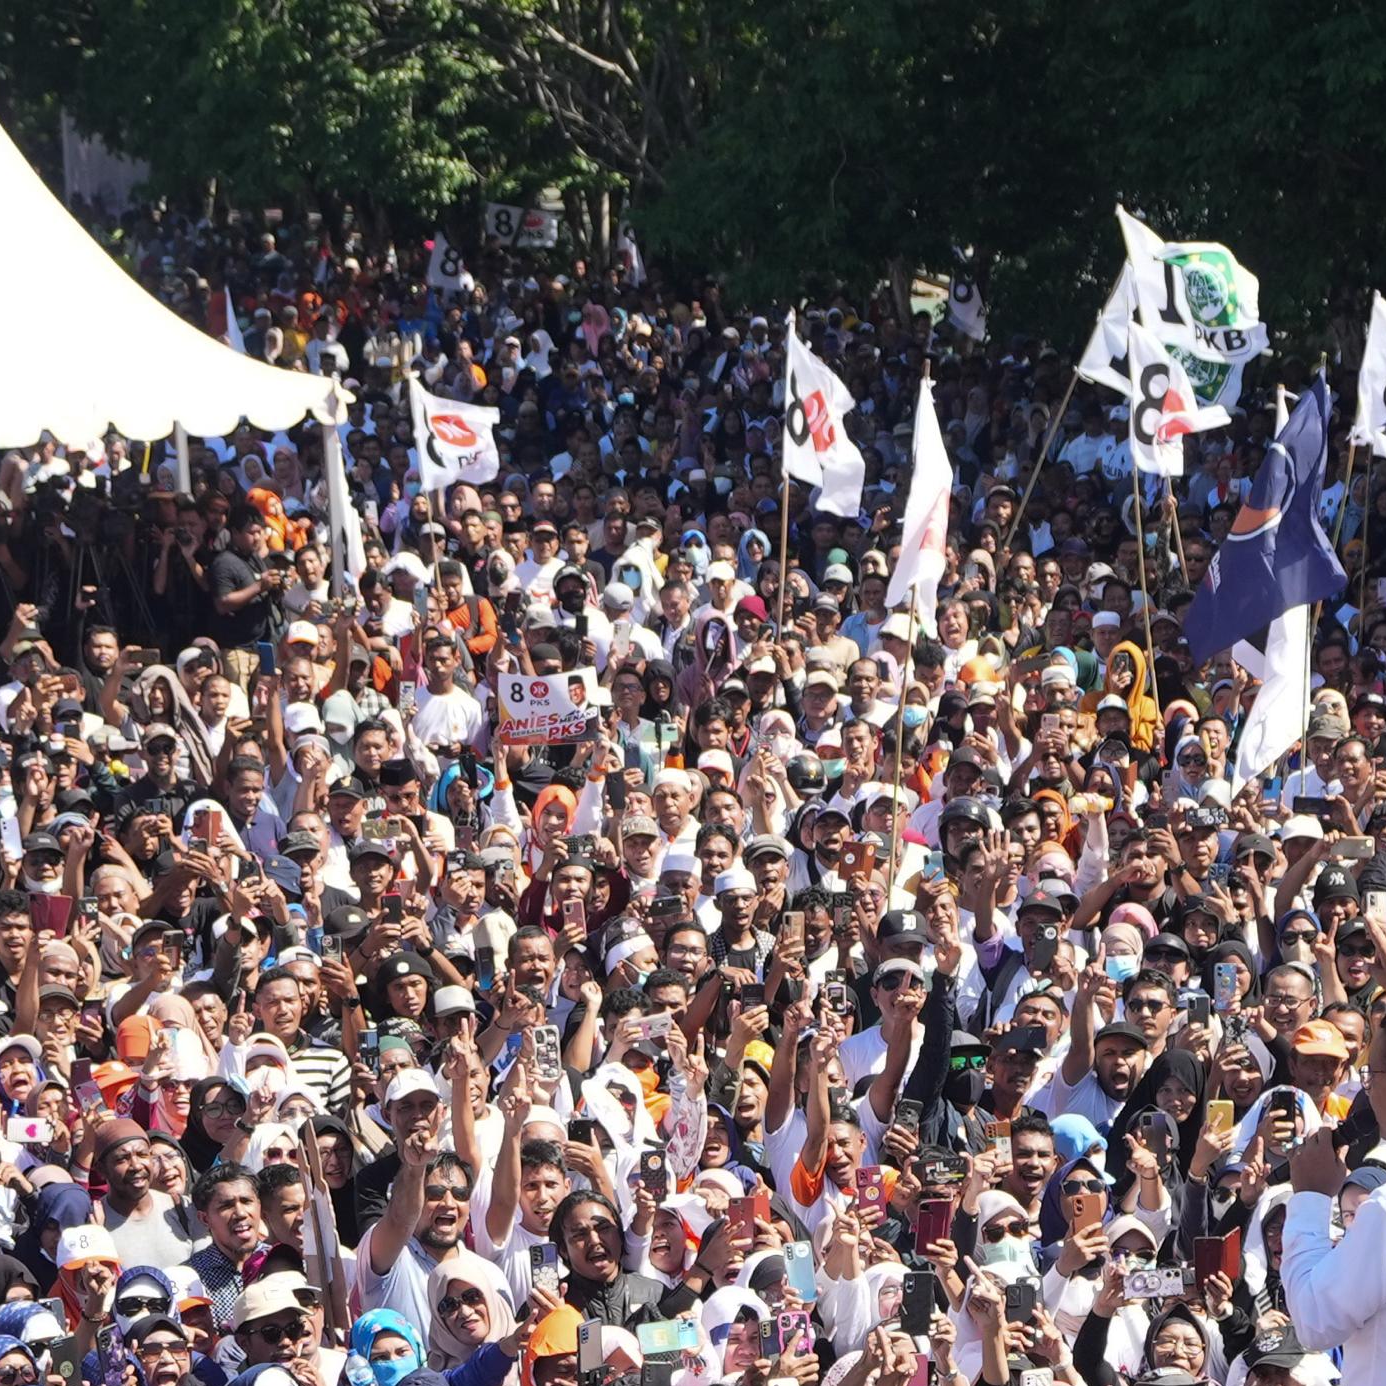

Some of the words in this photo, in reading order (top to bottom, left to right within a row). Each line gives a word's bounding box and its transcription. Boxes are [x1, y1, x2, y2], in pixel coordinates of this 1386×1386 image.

[510, 682, 524, 703] 8
[530, 699, 551, 707] PKS
[549, 720, 588, 742] PKS
[80, 1234, 90, 1249] 8
